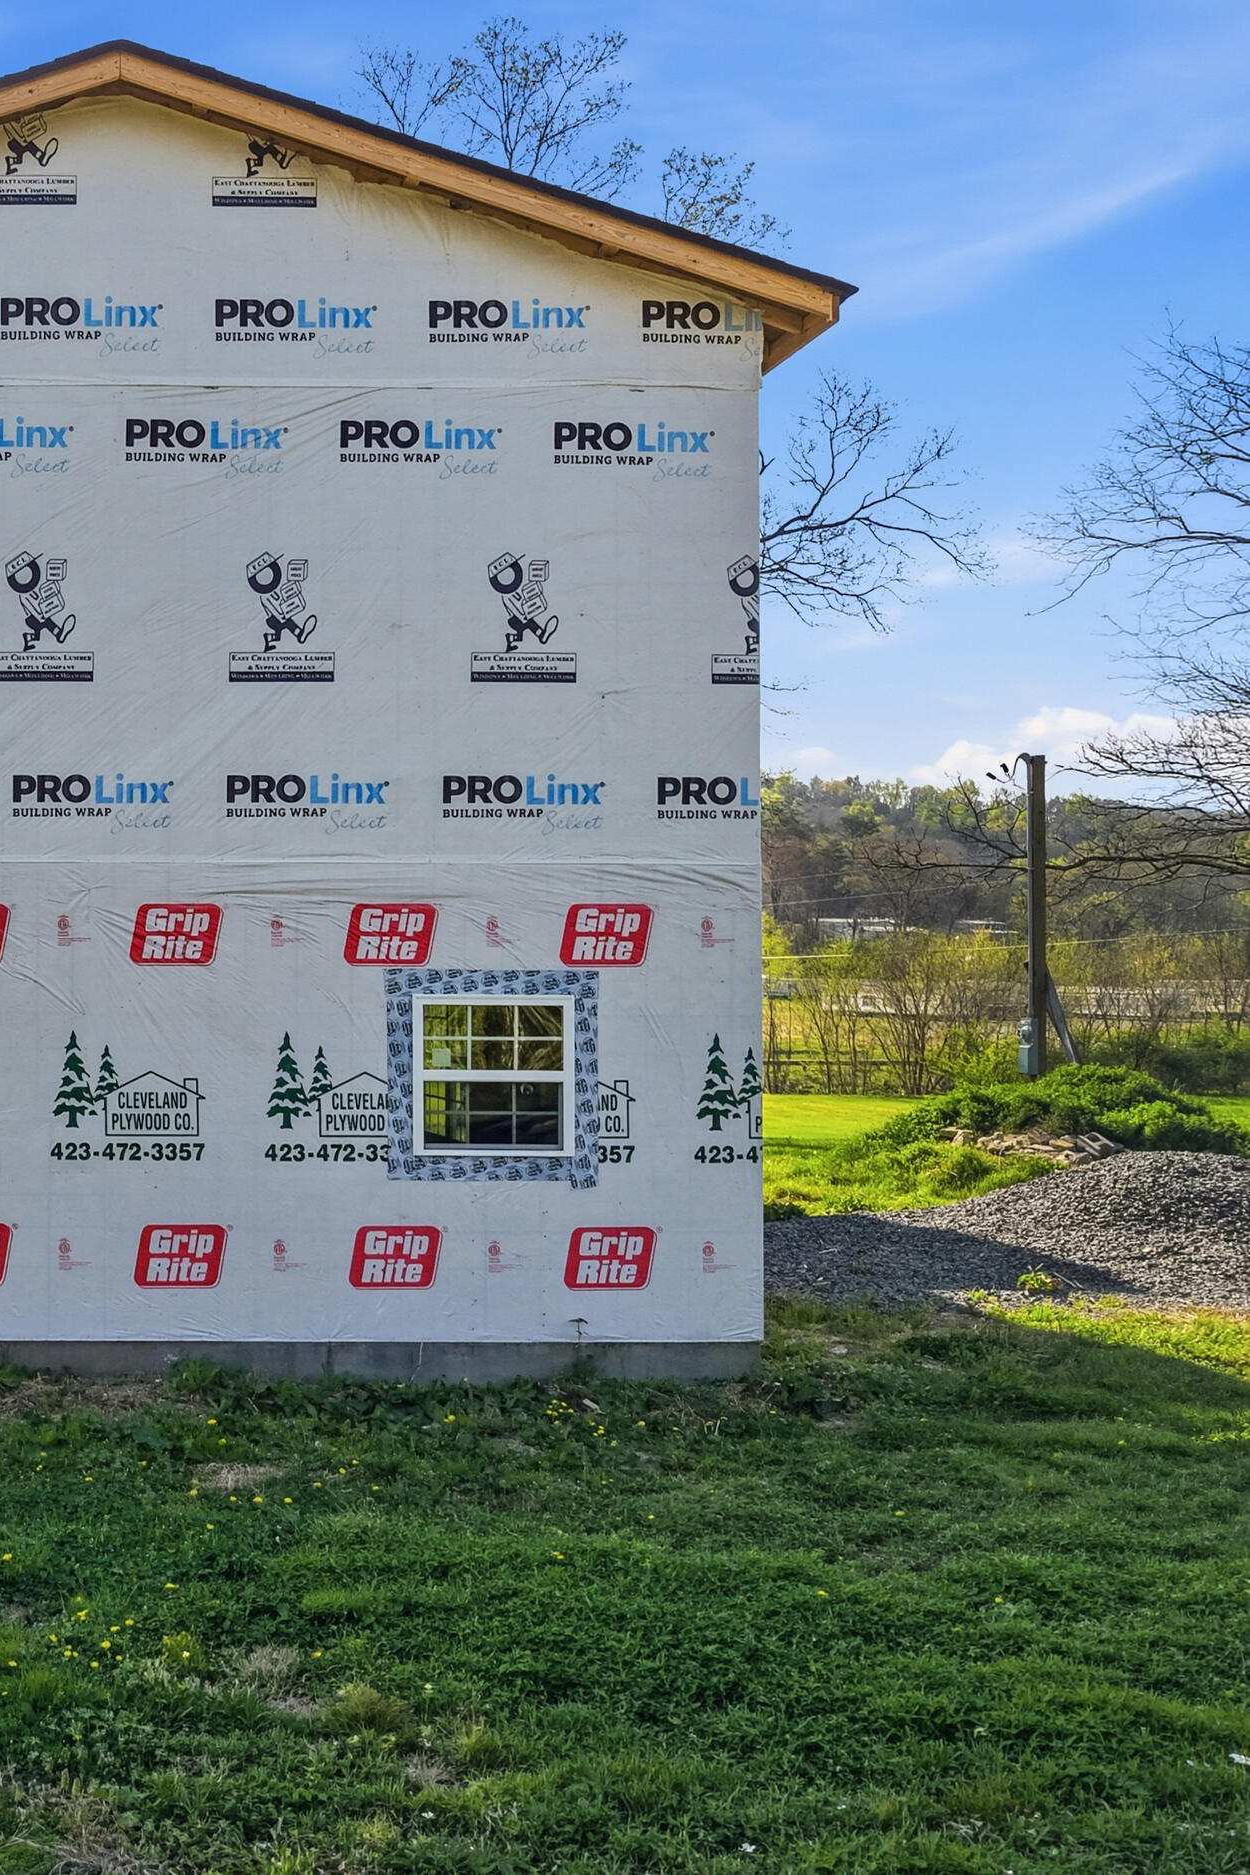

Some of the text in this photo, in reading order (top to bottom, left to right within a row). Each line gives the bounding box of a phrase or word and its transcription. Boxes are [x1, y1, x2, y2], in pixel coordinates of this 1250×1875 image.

[1, 330, 102, 341] BUILDING WRAP
[215, 330, 316, 342] BUILDING WRAP
[429, 332, 530, 344] BUILDING WRAP
[643, 333, 742, 344] BUILDING WRAP
[126, 452, 228, 463] BUILDING WRAP
[340, 452, 442, 464] BUILDING WRAP
[554, 456, 656, 467] BUILDING WRAP
[13, 806, 114, 818] BUILDING WRAP
[227, 806, 328, 818] BUILDING WRAP
[443, 807, 544, 818] BUILDING WRAP
[658, 809, 758, 820] BUILDING WRAP
[146, 907, 211, 936] Grip
[359, 908, 424, 936] Grip
[574, 908, 639, 937] Grip
[143, 935, 204, 960] Rite
[356, 936, 417, 960] Rite
[571, 936, 632, 961] Rite
[120, 1092, 190, 1110] CLEVELAND
[332, 1092, 388, 1111] CLEVELA
[113, 1112, 195, 1132] PLYWOOD CO.
[326, 1114, 385, 1132] PLYWOOD
[50, 1144, 205, 1162] 423-472-3357
[265, 1144, 389, 1162] 423-472-33
[150, 1229, 216, 1258] Grip
[365, 1230, 431, 1259] Grip
[580, 1231, 646, 1260] Grip
[147, 1257, 208, 1282] Rite
[362, 1258, 424, 1283] Rite
[577, 1259, 638, 1284] Rite
